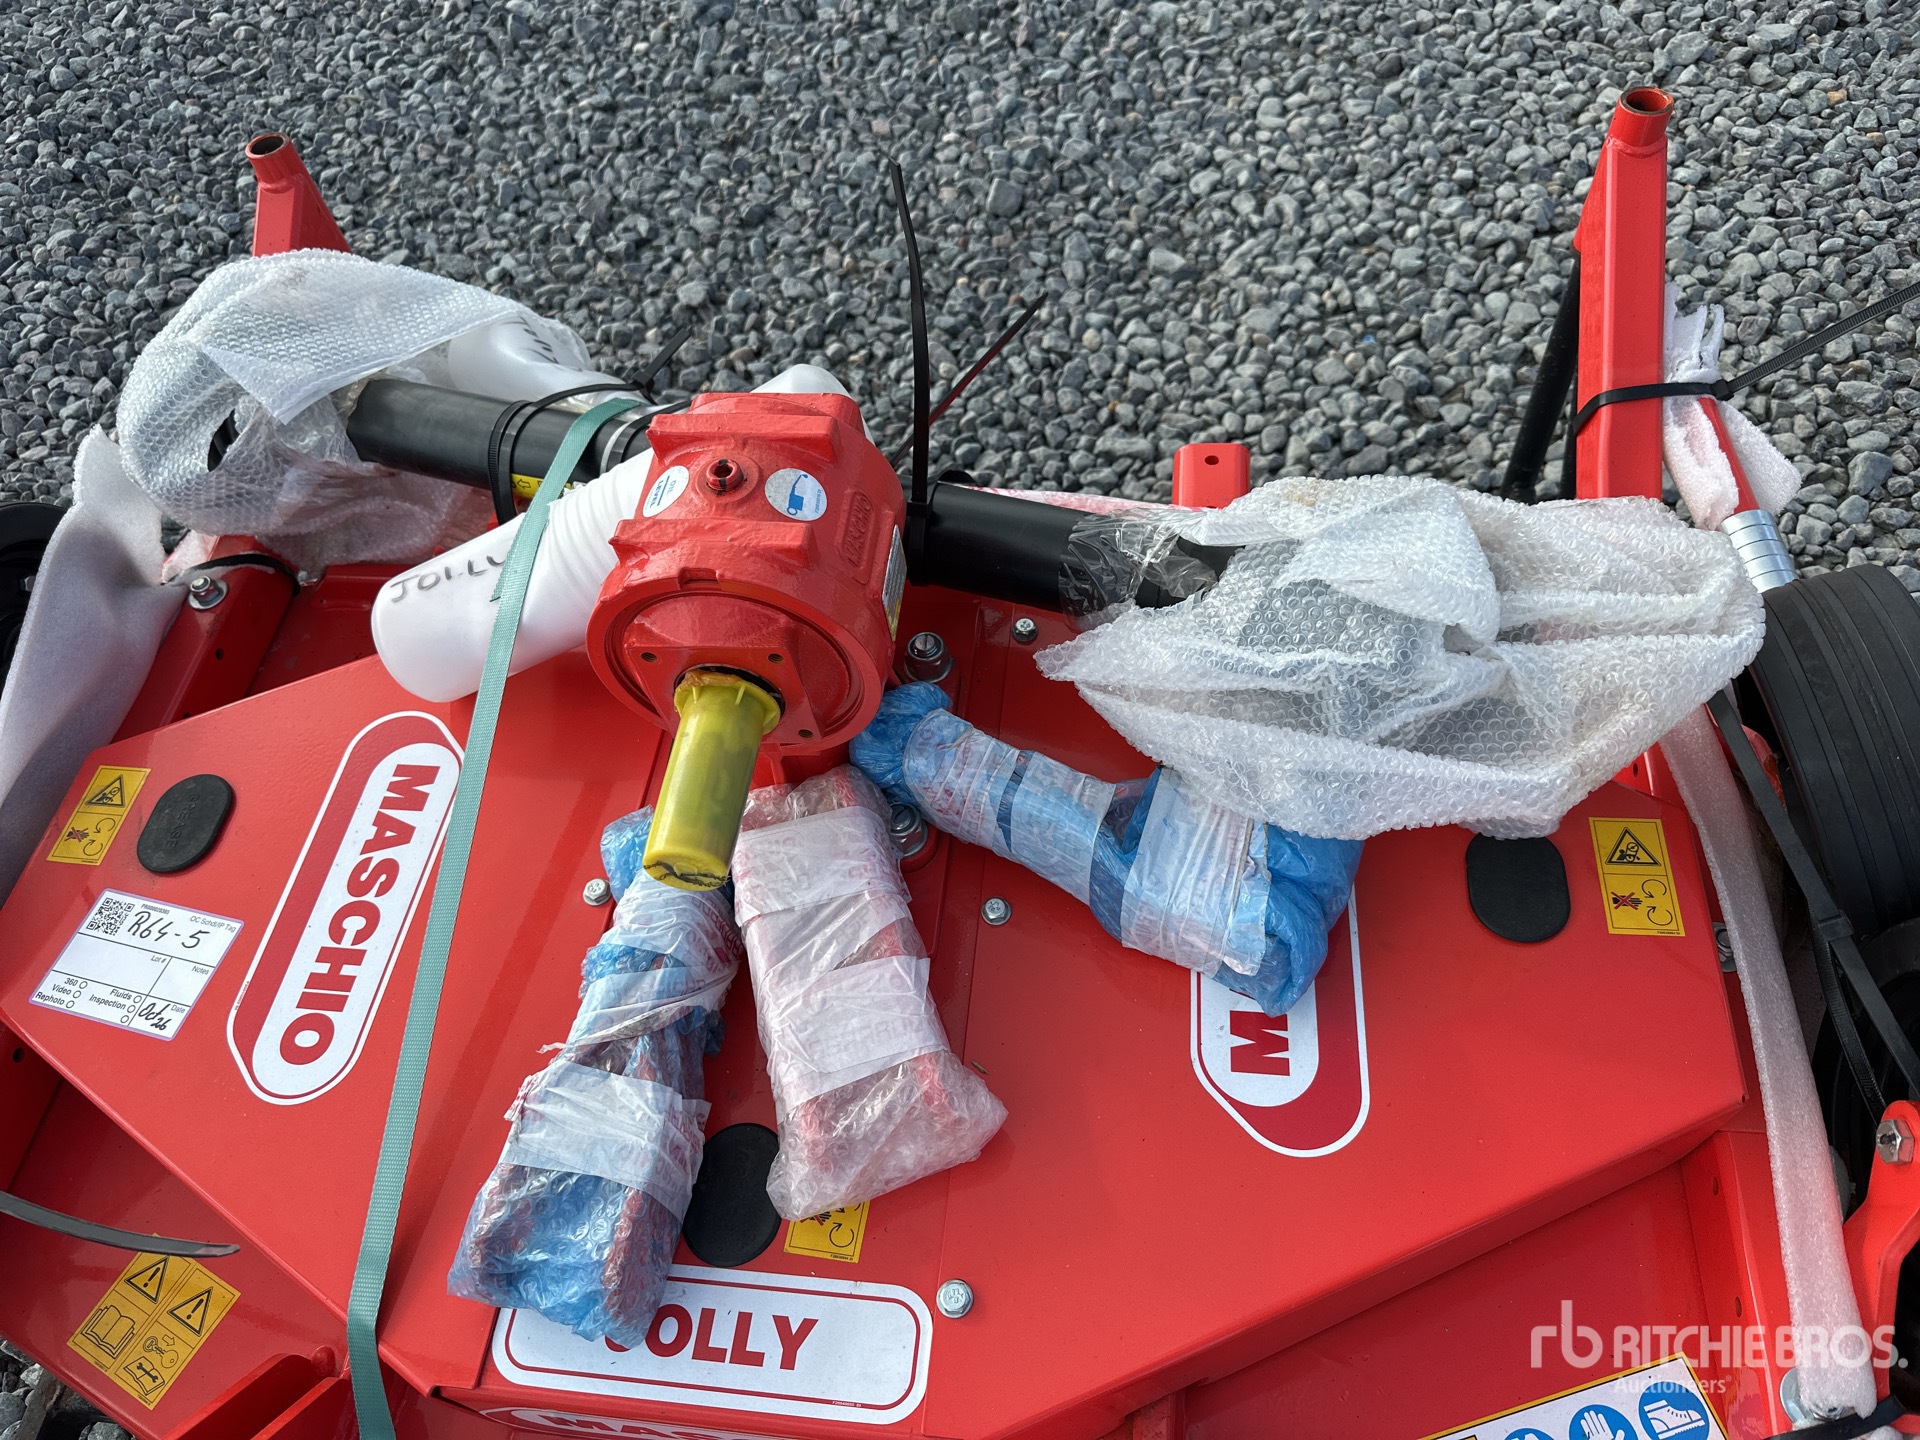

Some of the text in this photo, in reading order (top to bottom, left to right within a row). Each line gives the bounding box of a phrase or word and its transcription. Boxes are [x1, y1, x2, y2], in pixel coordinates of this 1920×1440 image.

[649, 479, 664, 508] LEVEL
[279, 764, 441, 1066] MASCHIO
[225, 923, 236, 933] Tag
[151, 954, 161, 963] Lot
[191, 965, 209, 975] Notes
[64, 977, 78, 986] 360
[52, 983, 72, 996] Video
[109, 988, 132, 1001] Fluids
[35, 991, 65, 1006] Rephoto
[88, 994, 126, 1010] Inspection
[170, 1004, 185, 1014] Date
[604, 1303, 819, 1371] OLLY
